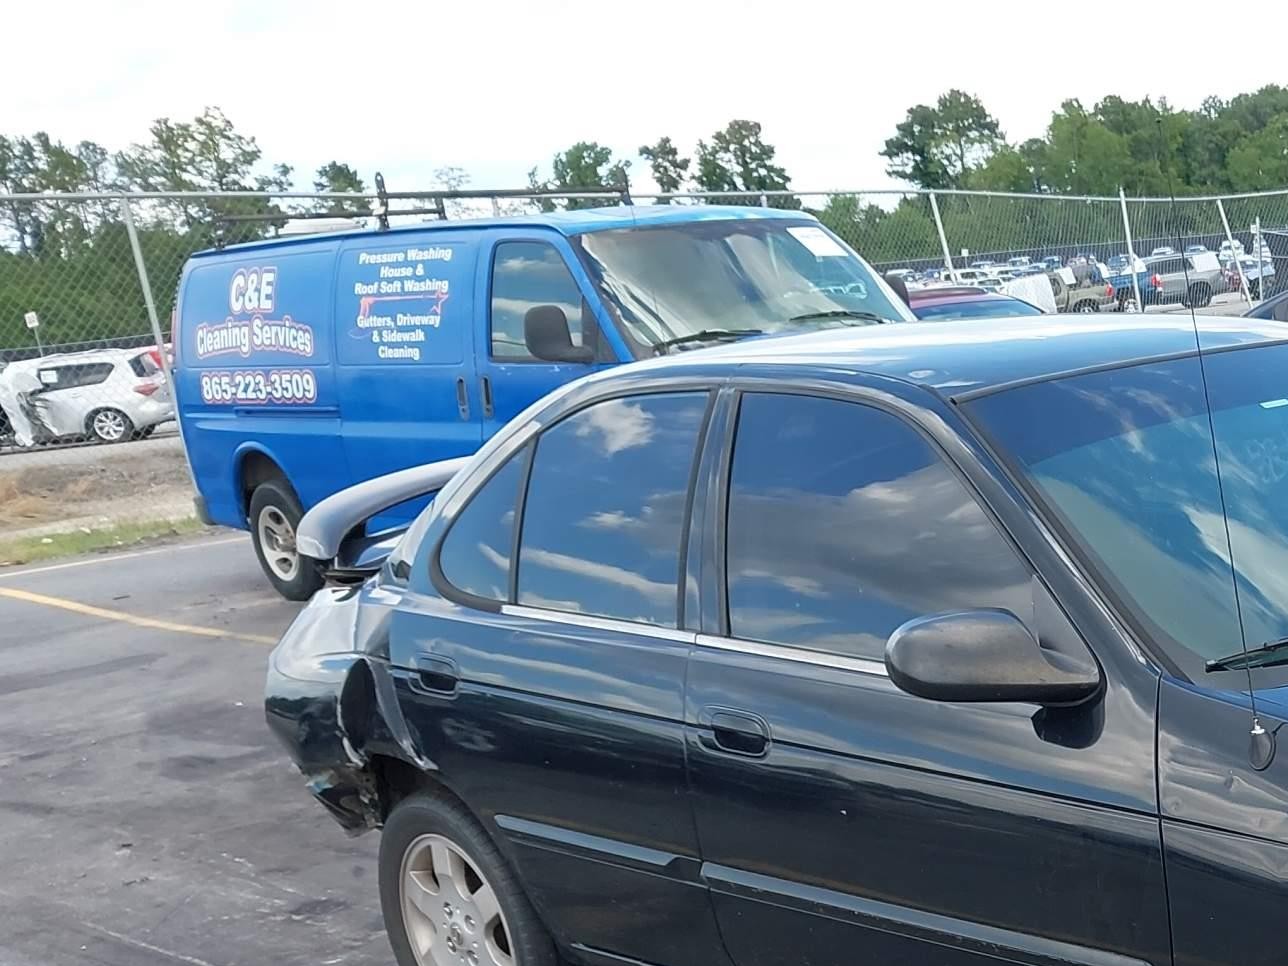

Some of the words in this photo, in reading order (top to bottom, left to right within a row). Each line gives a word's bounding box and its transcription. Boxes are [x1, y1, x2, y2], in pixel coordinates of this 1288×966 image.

[359, 252, 405, 264] Pressure
[407, 247, 452, 262] Washing
[380, 265, 413, 278] House
[415, 263, 425, 276] &
[231, 271, 275, 311] C&E
[355, 282, 379, 295] Roof
[379, 280, 402, 293] Soft
[403, 278, 449, 293] Washing
[357, 315, 395, 328] Gutters,
[396, 313, 441, 328] Driveway
[197, 322, 249, 354] Cleaning
[252, 318, 311, 353] Services
[372, 330, 380, 342] &
[382, 329, 425, 342] Sidewalk
[378, 345, 420, 360] Cleaning
[202, 373, 315, 401] 865-223-3509
